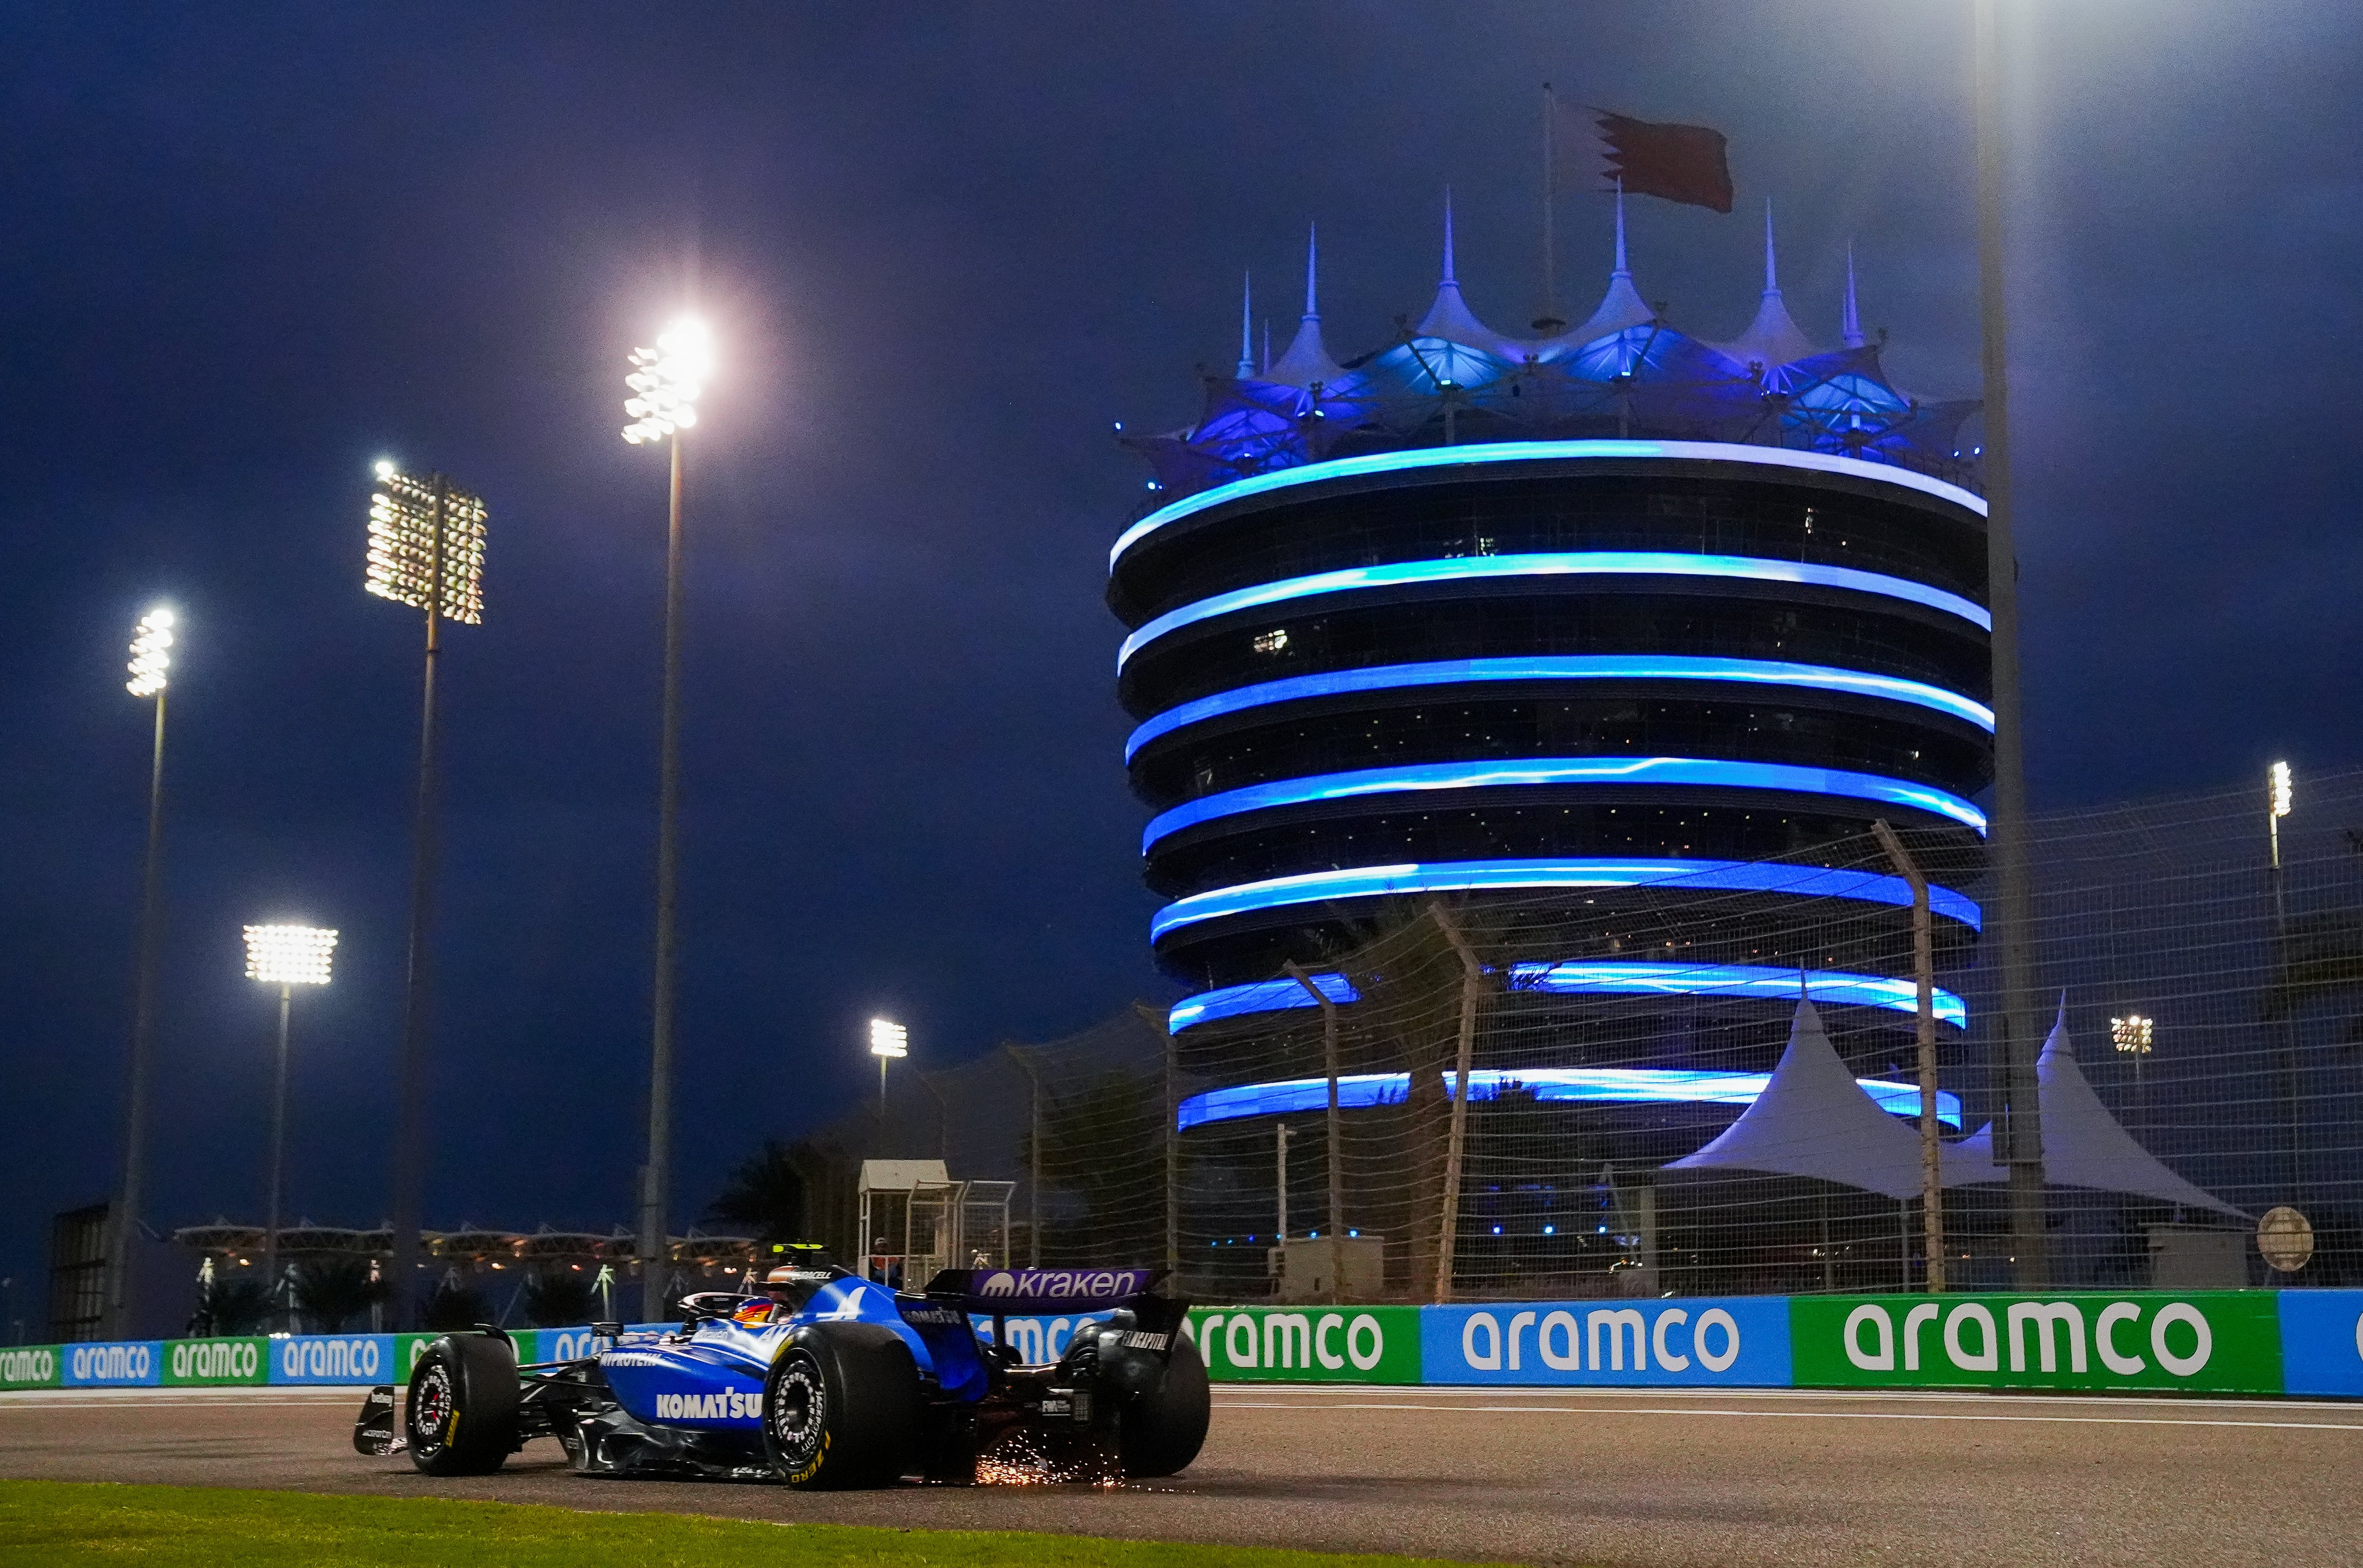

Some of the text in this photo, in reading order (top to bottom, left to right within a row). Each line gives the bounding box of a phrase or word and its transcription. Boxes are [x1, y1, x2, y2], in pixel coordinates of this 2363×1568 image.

[1016, 1272, 1135, 1297] kraken
[1180, 1313, 1383, 1370] ramco
[1462, 1308, 1740, 1372] aramco
[1844, 1302, 2212, 1376] aramco
[73, 1346, 149, 1379] aramco
[173, 1343, 257, 1378] aramco
[283, 1339, 379, 1377] aramco
[656, 1386, 763, 1419] KOMATSU
